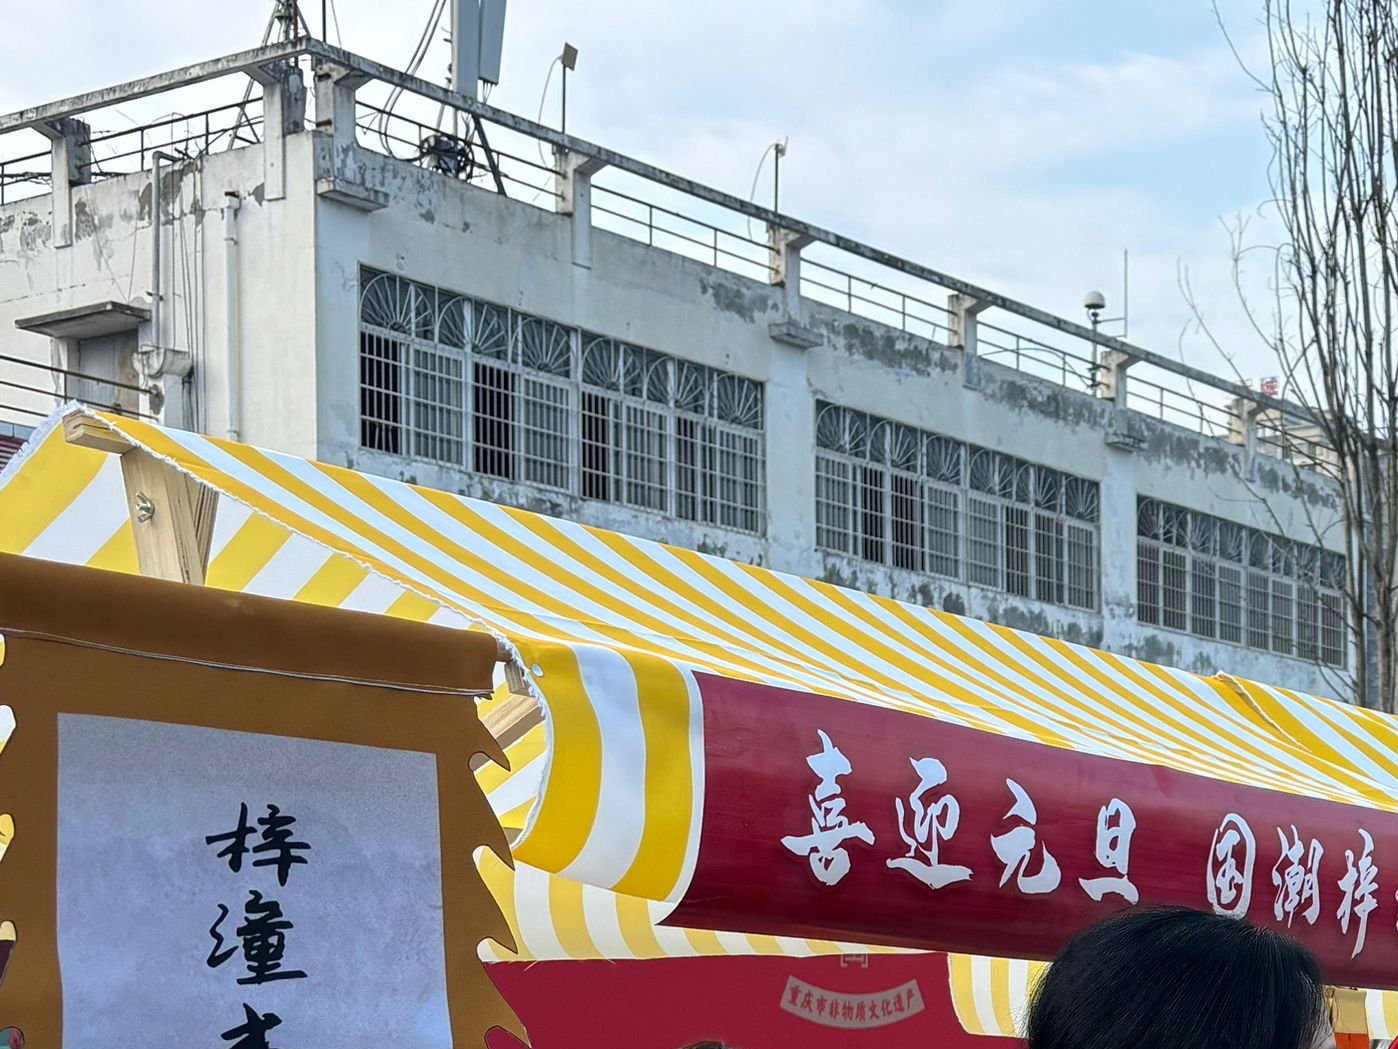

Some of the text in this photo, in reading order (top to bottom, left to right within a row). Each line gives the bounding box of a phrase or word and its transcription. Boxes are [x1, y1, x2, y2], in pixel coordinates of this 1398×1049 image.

[781, 729, 1139, 904] 喜迎元旦
[788, 984, 916, 1022] 重庆市非物质文化遗产
